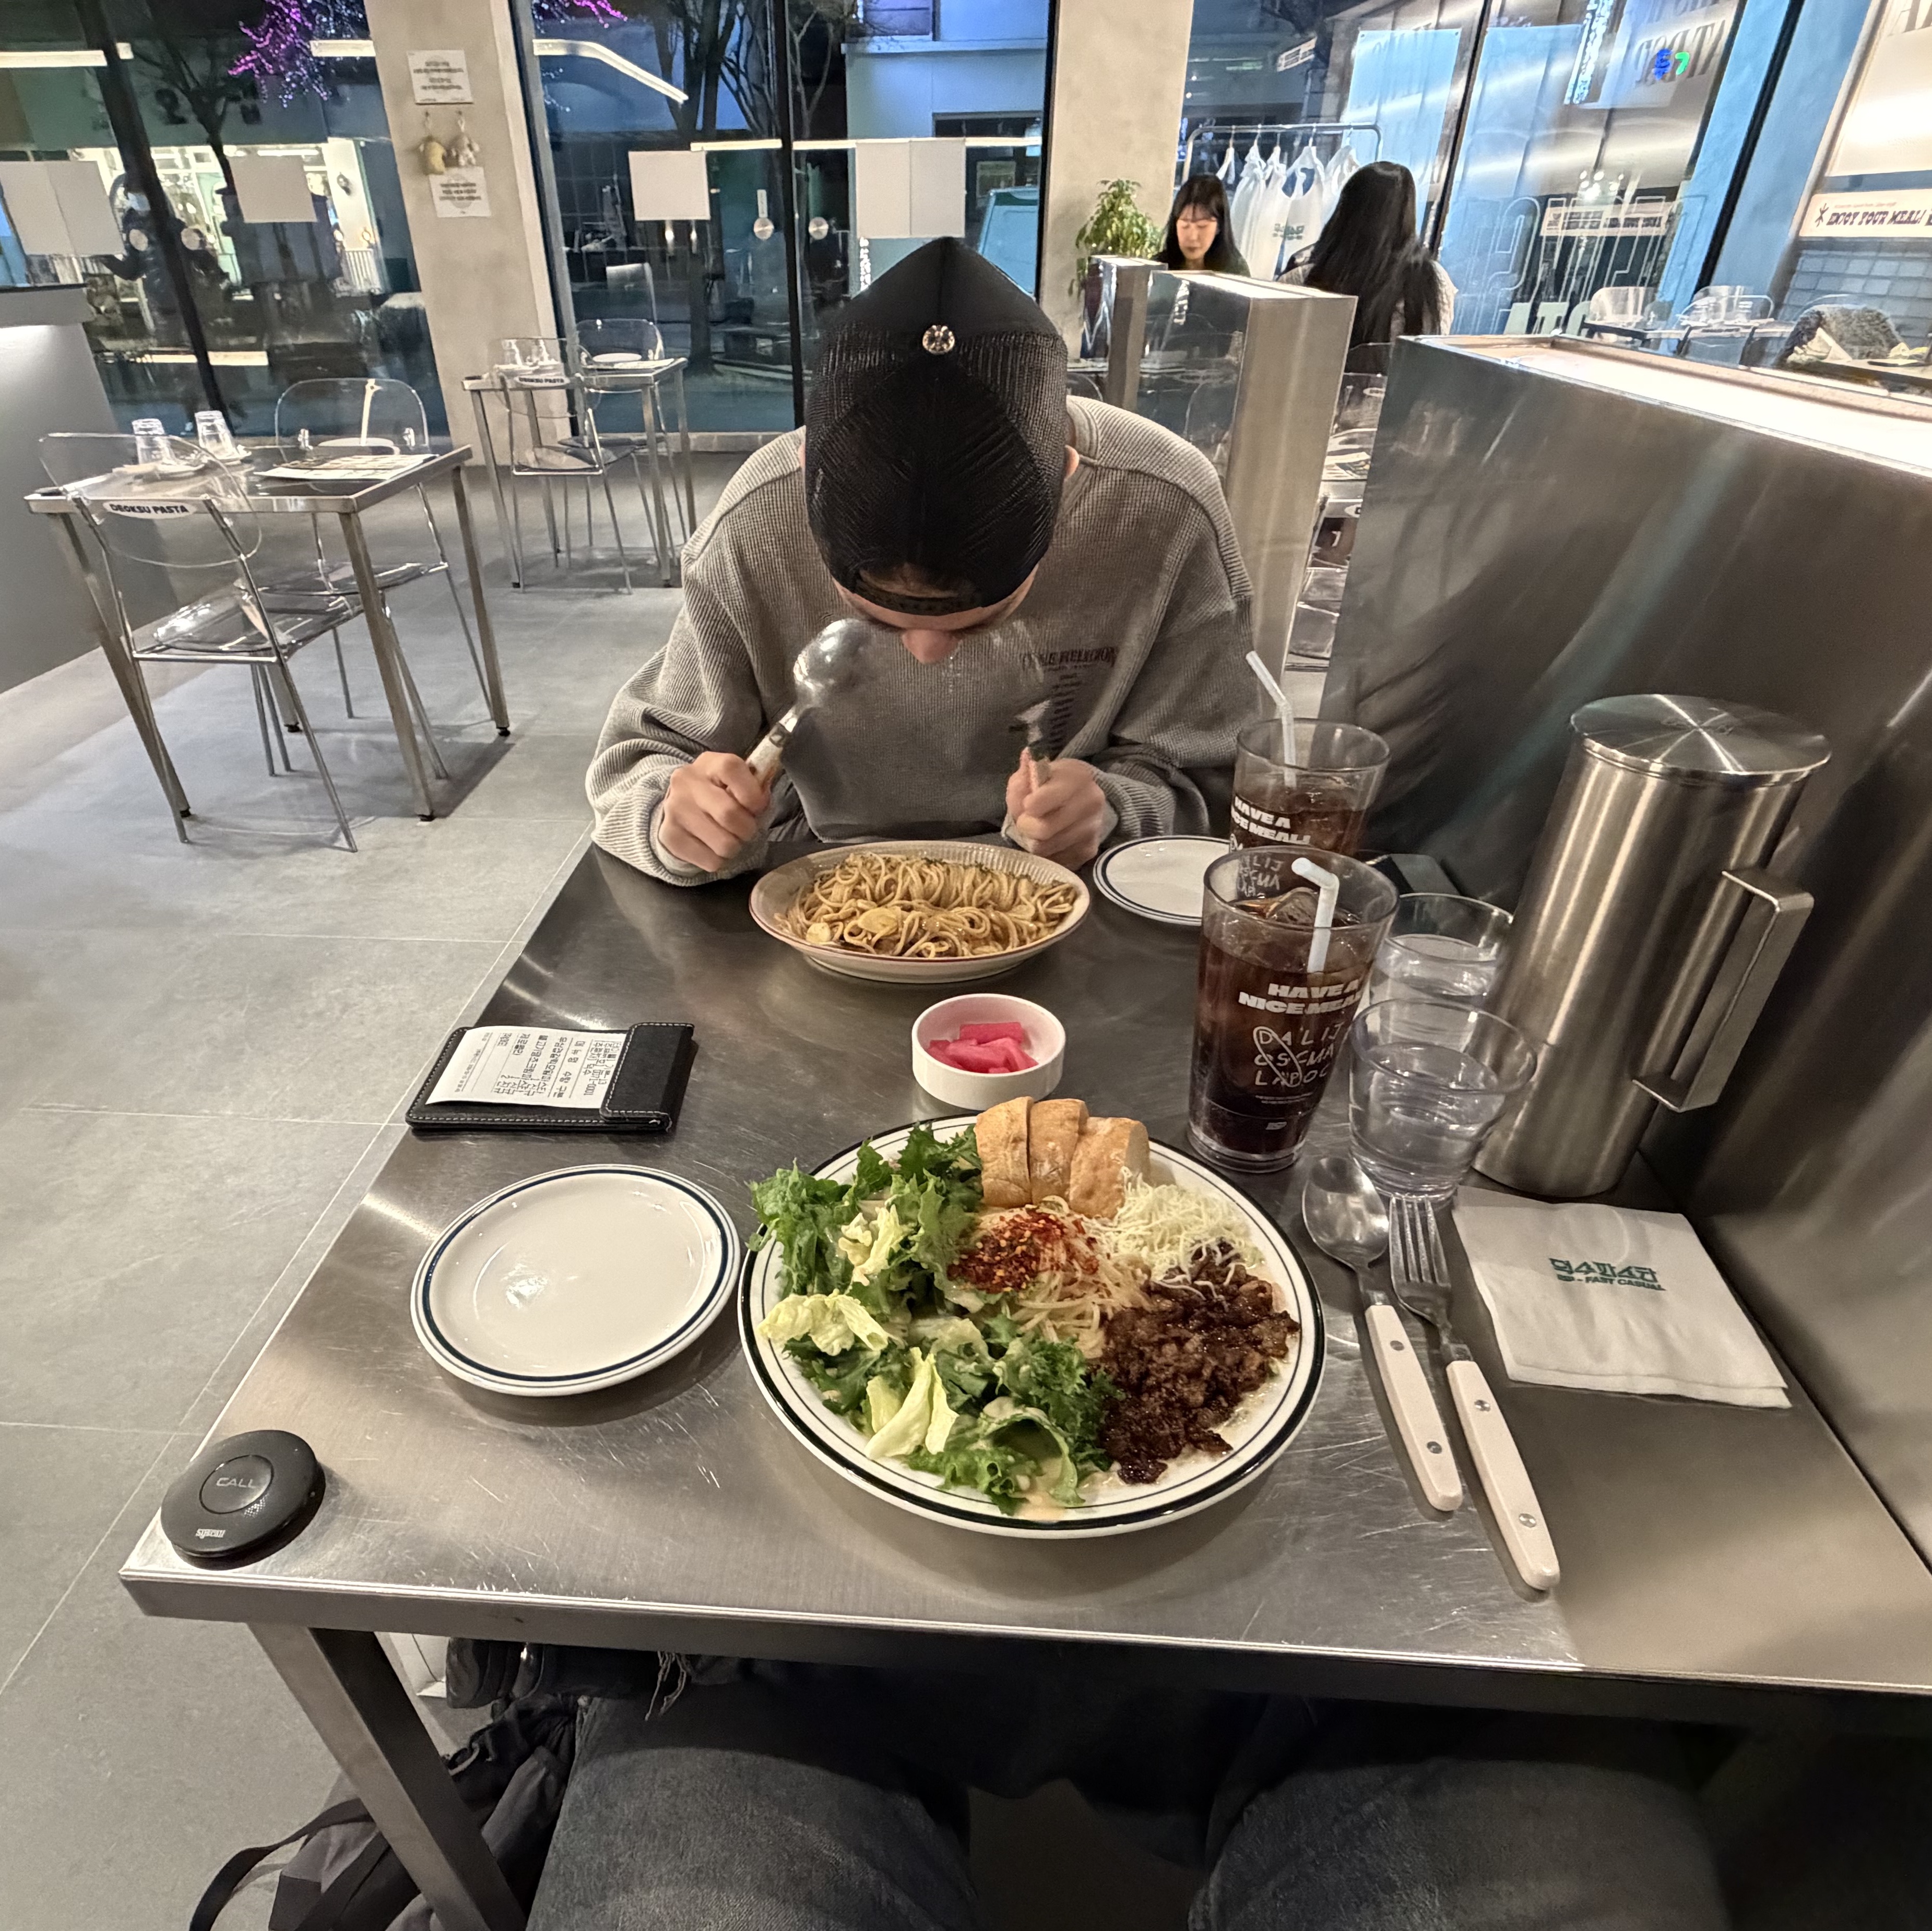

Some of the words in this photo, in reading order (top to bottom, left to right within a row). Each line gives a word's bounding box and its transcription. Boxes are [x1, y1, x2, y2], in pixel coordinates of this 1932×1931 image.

[1826, 211, 1860, 225] ENJOY
[1858, 211, 1889, 225] YOUR
[109, 504, 151, 514] DEOKSU
[152, 505, 189, 514] PASTA
[1235, 796, 1274, 825] HAVE
[1275, 817, 1291, 829] A
[1268, 983, 1344, 998] HAVE
[1343, 979, 1359, 993] A
[1238, 992, 1305, 1015] NICE
[553, 1085, 567, 1098] 구분
[1585, 1276, 1614, 1284] FAST
[1617, 1279, 1666, 1291] CASUAL
[216, 1477, 259, 1488] CALL
